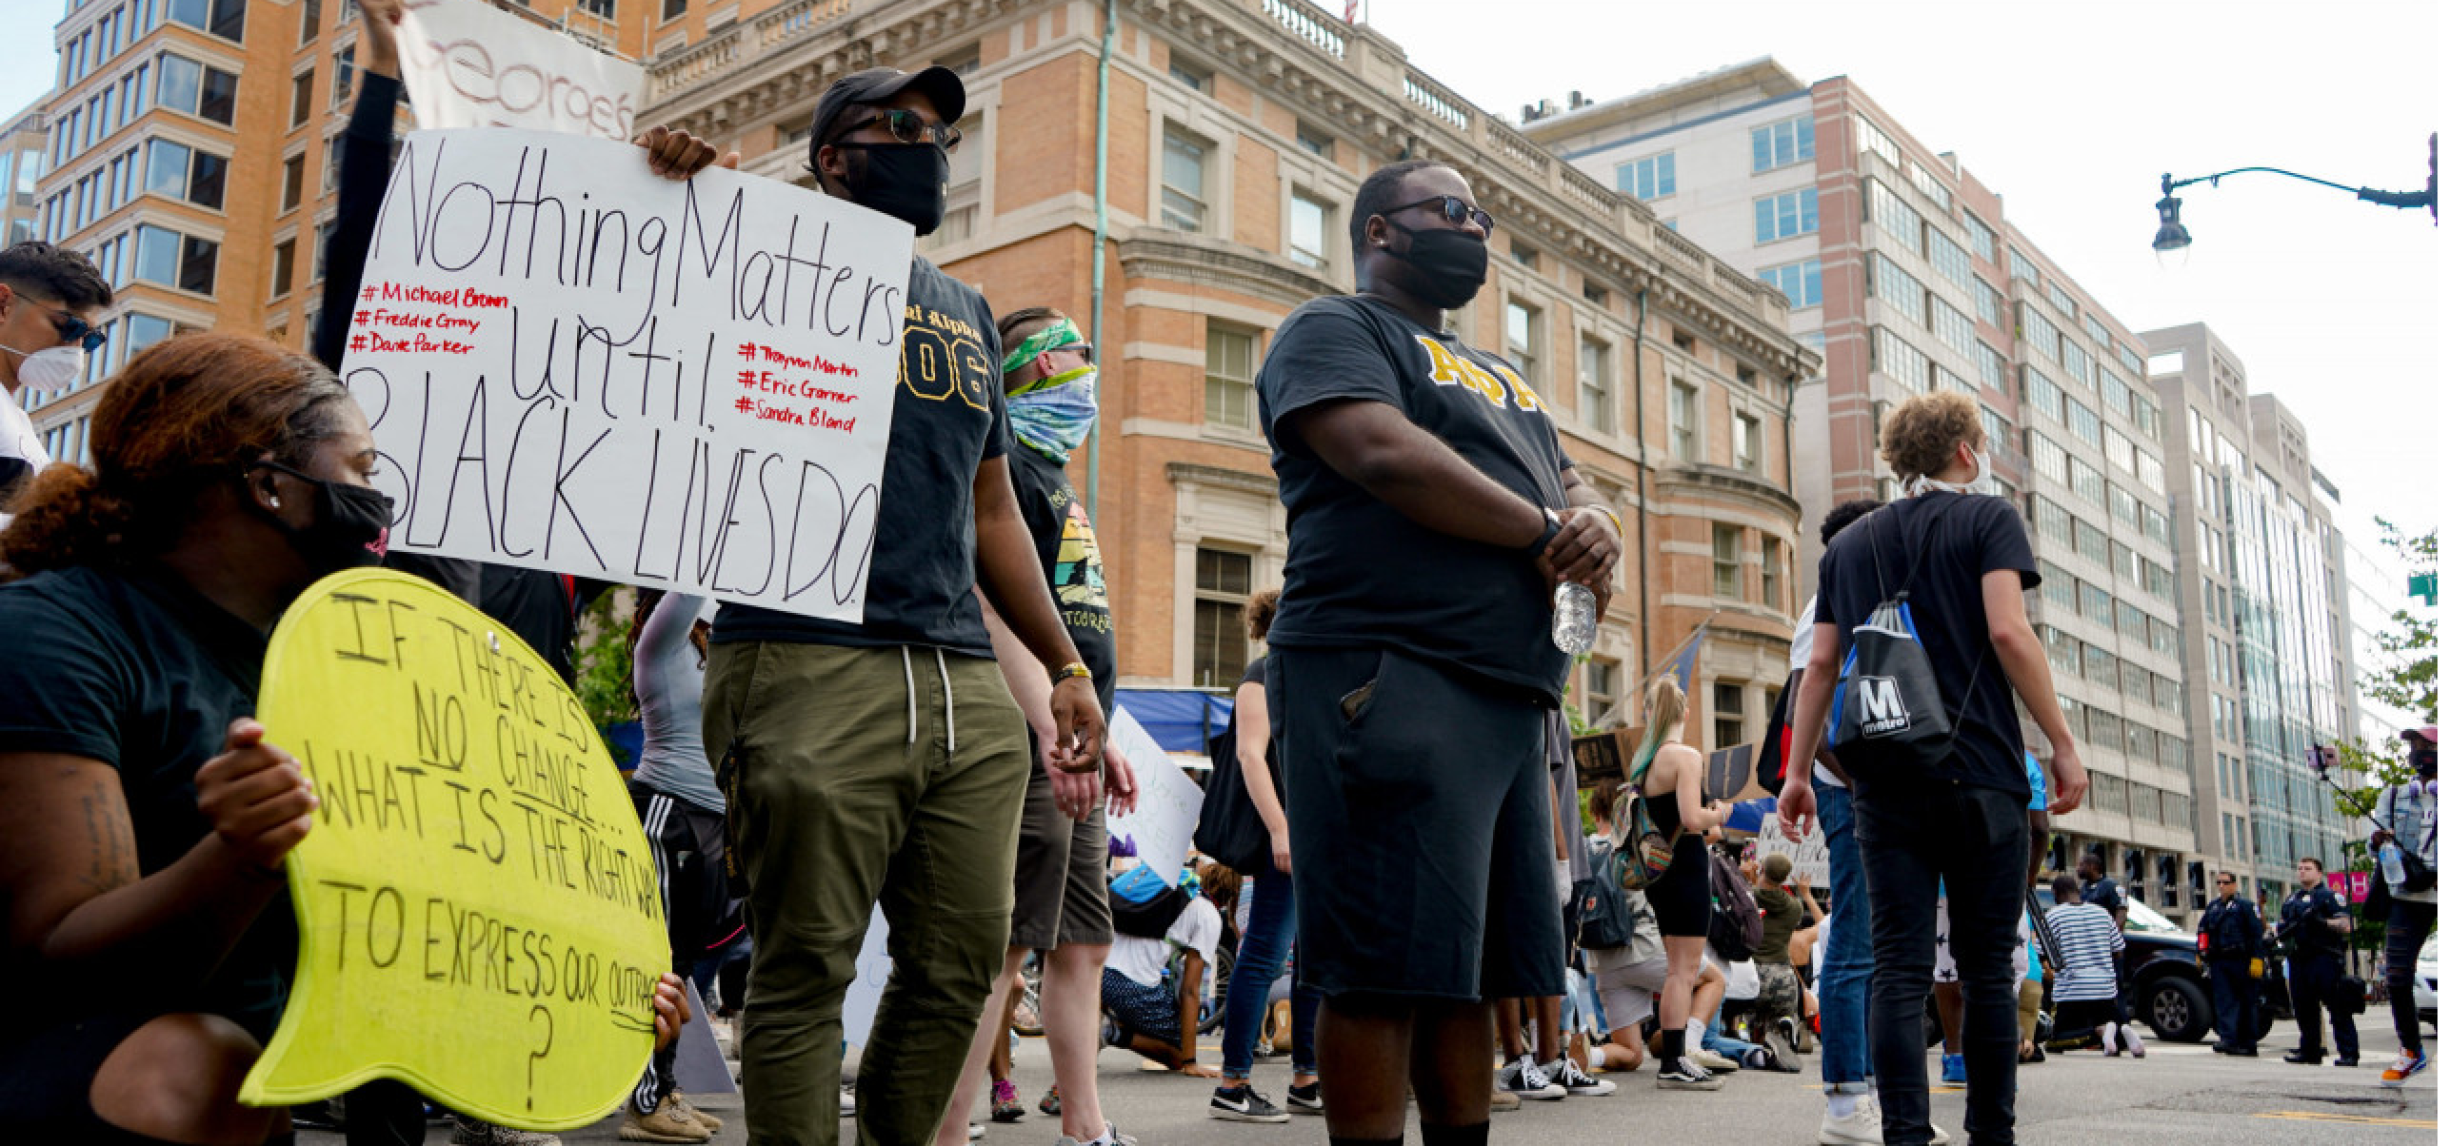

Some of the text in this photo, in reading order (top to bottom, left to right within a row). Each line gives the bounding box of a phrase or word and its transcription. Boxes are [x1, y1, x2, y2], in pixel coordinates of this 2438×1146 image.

[374, 136, 901, 347] Nothing Matters
[435, 311, 481, 335] Gray
[463, 286, 509, 308] Brown
[414, 332, 475, 354] Parker
[812, 354, 859, 377] Martin
[808, 406, 856, 434] Bland
[346, 366, 613, 572] BLACK
[634, 427, 783, 596] LIVES
[330, 593, 588, 754] IF THERE IS
[1860, 679, 1904, 722] M
[413, 679, 468, 772] NO
[1863, 717, 1905, 734] metro
[303, 738, 428, 838] WHAT
[444, 780, 505, 865] IS
[511, 800, 578, 890] THE
[578, 825, 630, 909] RIGHT
[320, 880, 656, 1013] TO EXPRESS OUR OUTRAG
[526, 1004, 553, 1112] ?
